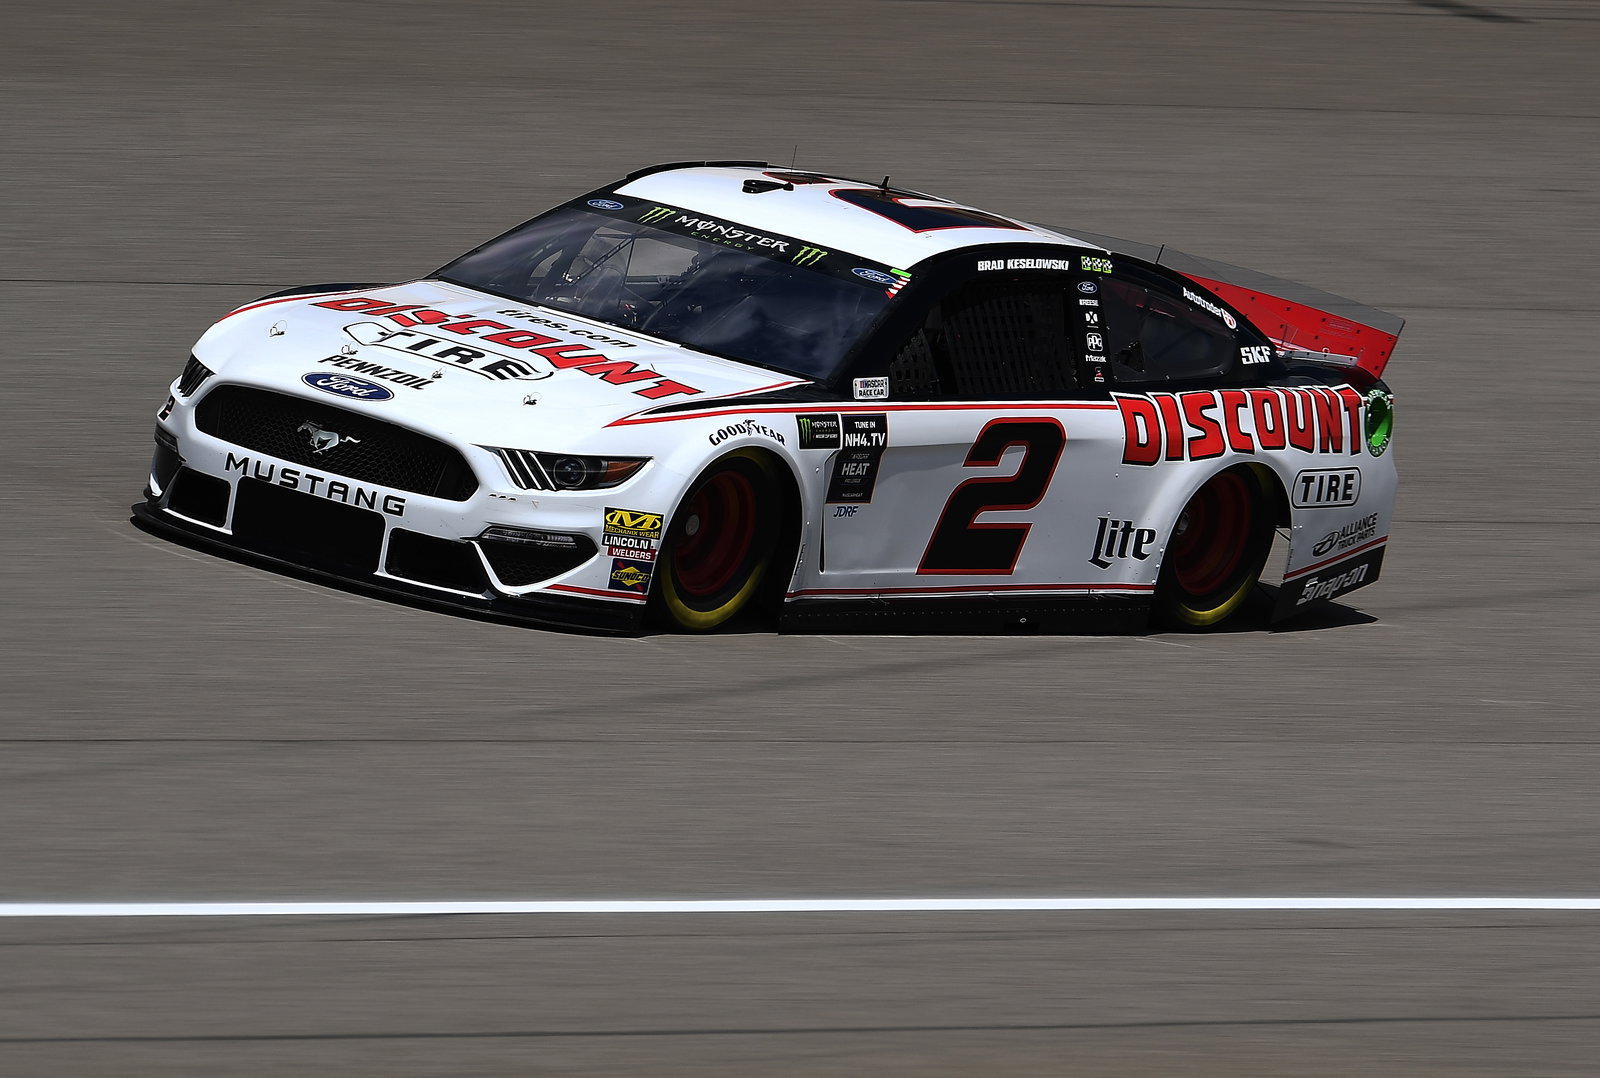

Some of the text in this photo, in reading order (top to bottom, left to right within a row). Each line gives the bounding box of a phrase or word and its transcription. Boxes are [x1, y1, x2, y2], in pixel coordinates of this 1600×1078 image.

[675, 215, 789, 252] MONSTER
[977, 258, 1069, 271] BRAD KESELOWSKI
[496, 309, 637, 348] tires.com
[308, 297, 705, 399] DISCOUNT
[370, 331, 534, 380] TIRE
[1240, 346, 1271, 364] SKF
[317, 354, 434, 390] PENNZOIL
[316, 374, 378, 398] Ford
[873, 388, 885, 396] CAR
[854, 421, 869, 429] TUNE
[1110, 383, 1365, 466] DISCOUNT
[845, 432, 886, 447] NH4.TV
[841, 462, 870, 476] HEAT
[225, 452, 407, 517] MUSTANG
[915, 416, 1067, 576] 2
[1301, 474, 1355, 503] TIRE
[833, 506, 859, 518] JDRF
[605, 524, 660, 539] MECHANIX WEAR
[1339, 512, 1378, 540] ALLIANCE
[604, 535, 649, 550] LINCOLN
[612, 547, 652, 560] WELDERS
[1088, 516, 1157, 570] Lite
[613, 570, 650, 582] SUNOCO
